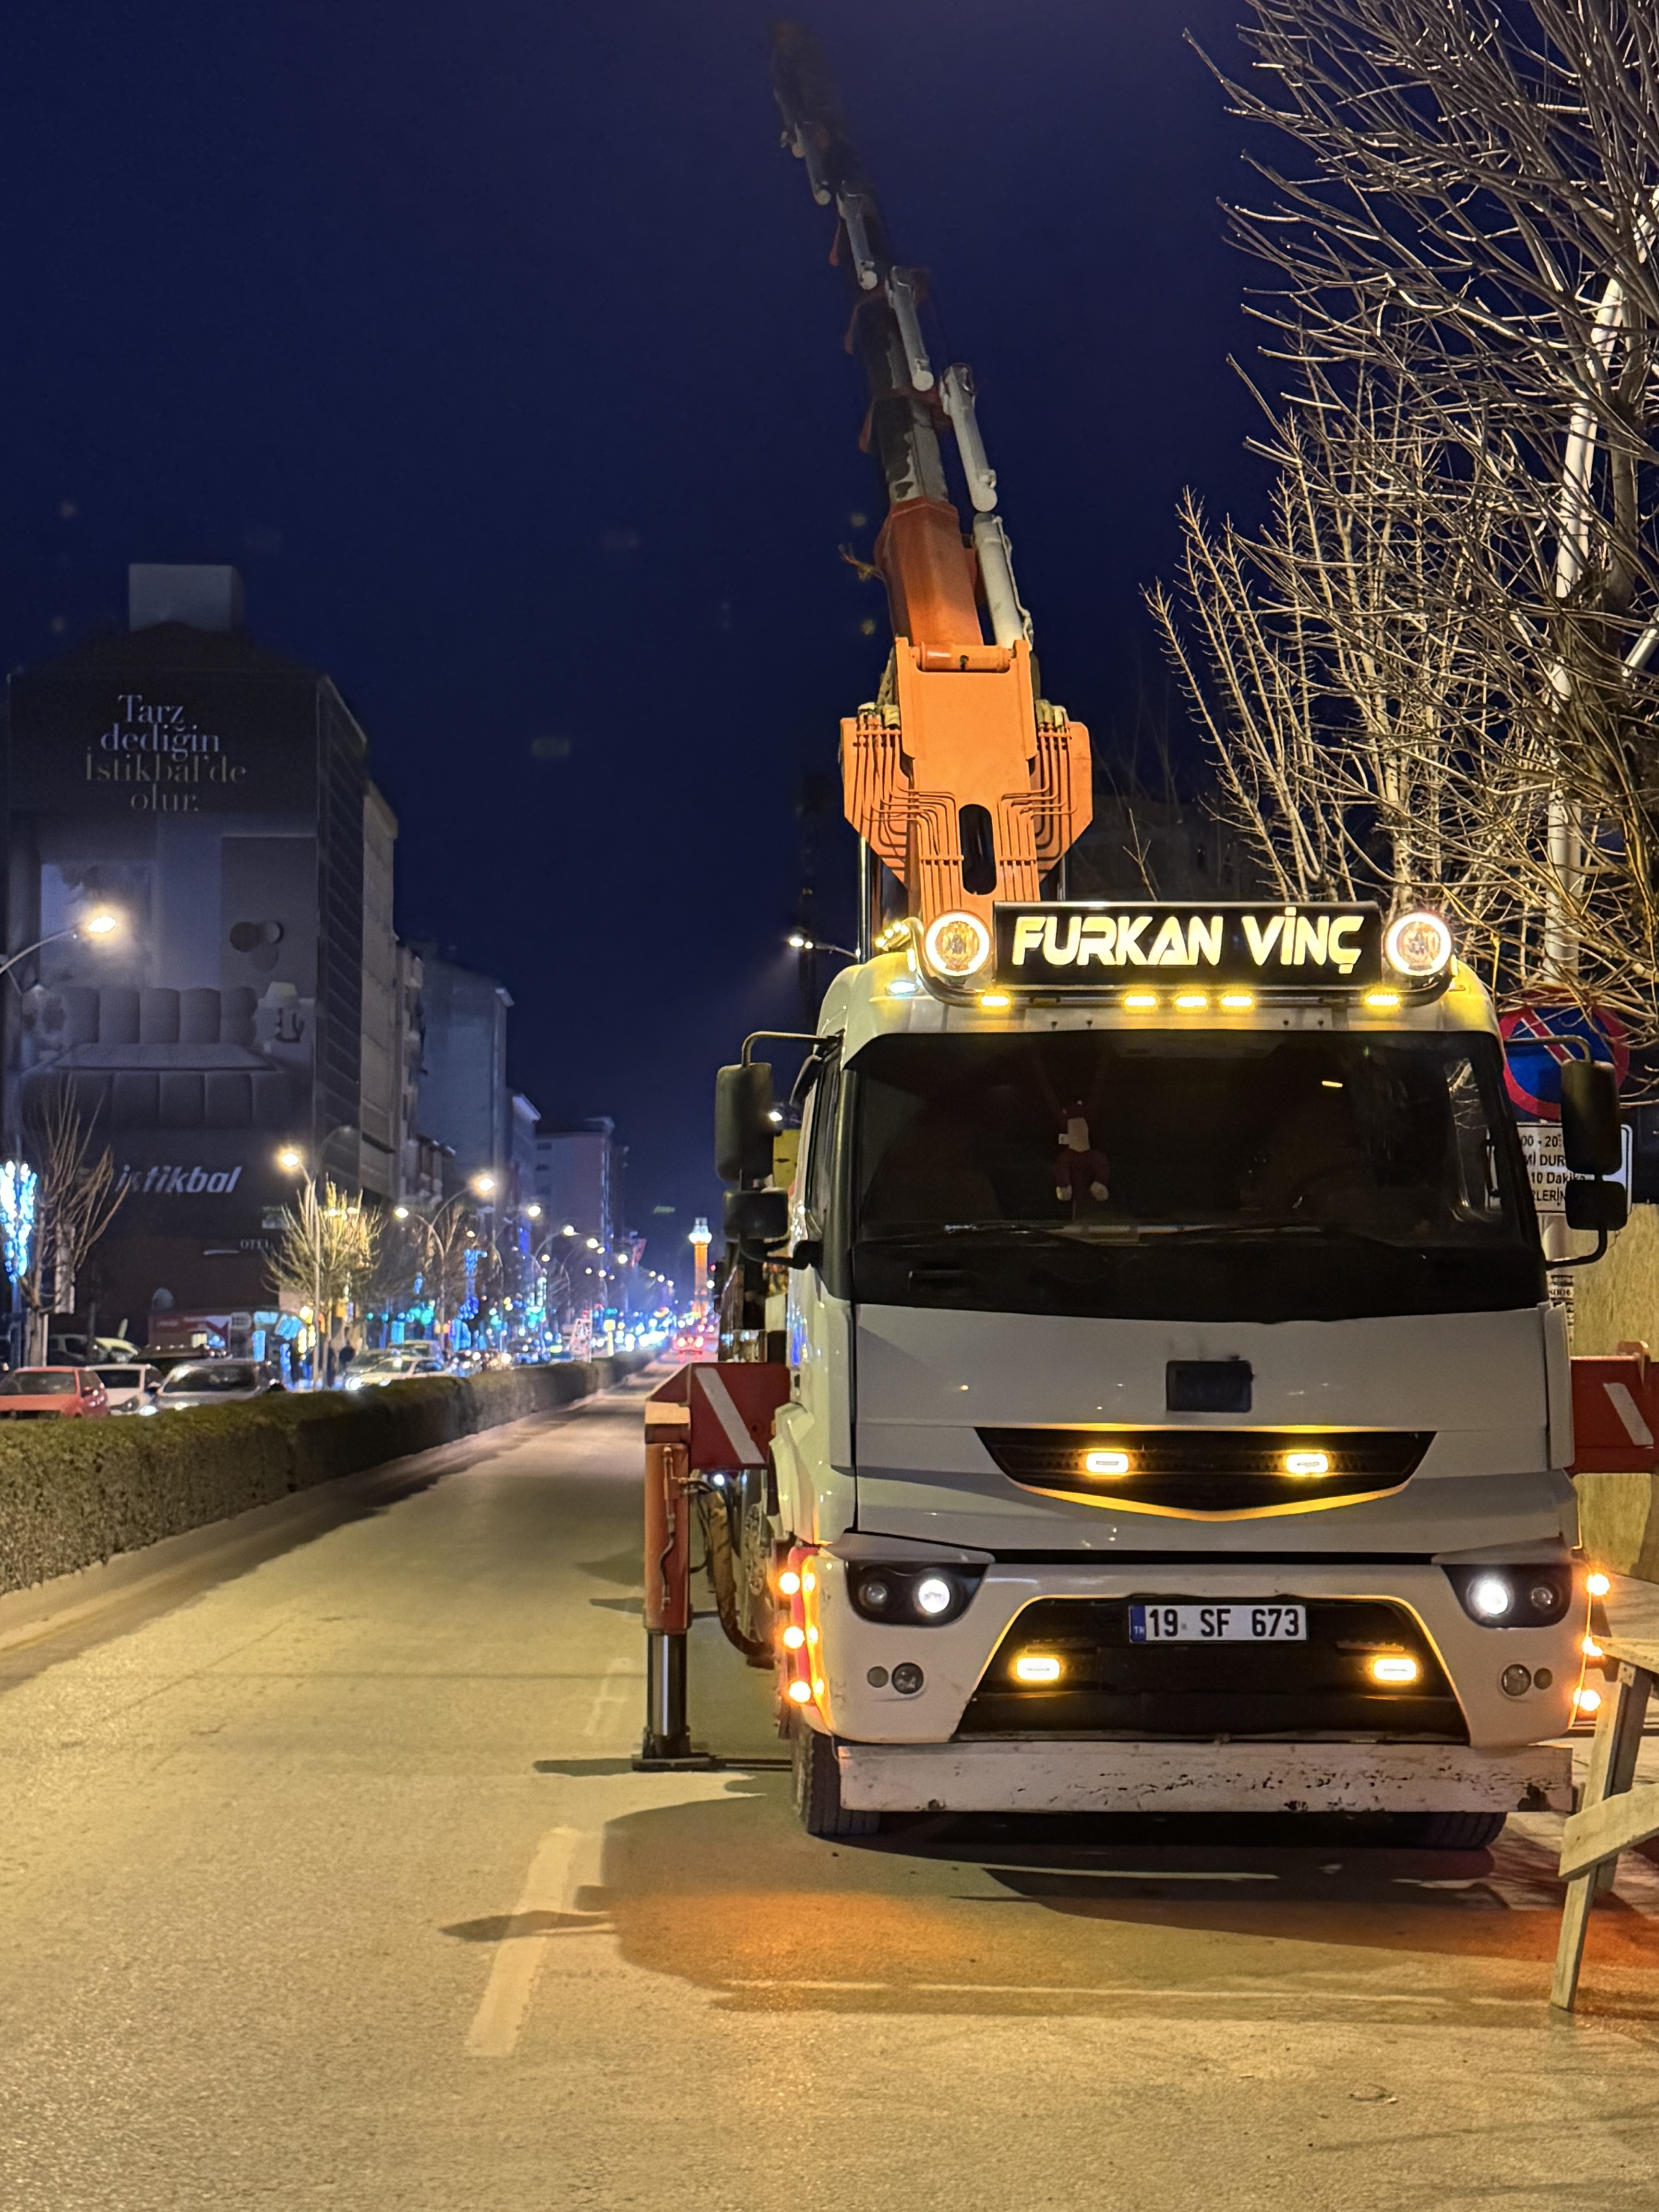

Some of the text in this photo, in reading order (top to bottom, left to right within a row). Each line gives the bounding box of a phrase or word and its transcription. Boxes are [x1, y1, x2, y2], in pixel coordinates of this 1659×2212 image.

[119, 695, 183, 723] Tarz
[100, 723, 219, 762] dediğin
[1012, 906, 1365, 974] FURKAN VİNÇ
[1149, 1609, 1178, 1637] 19
[1200, 1608, 1231, 1637] SF
[1251, 1608, 1299, 1637] 673
